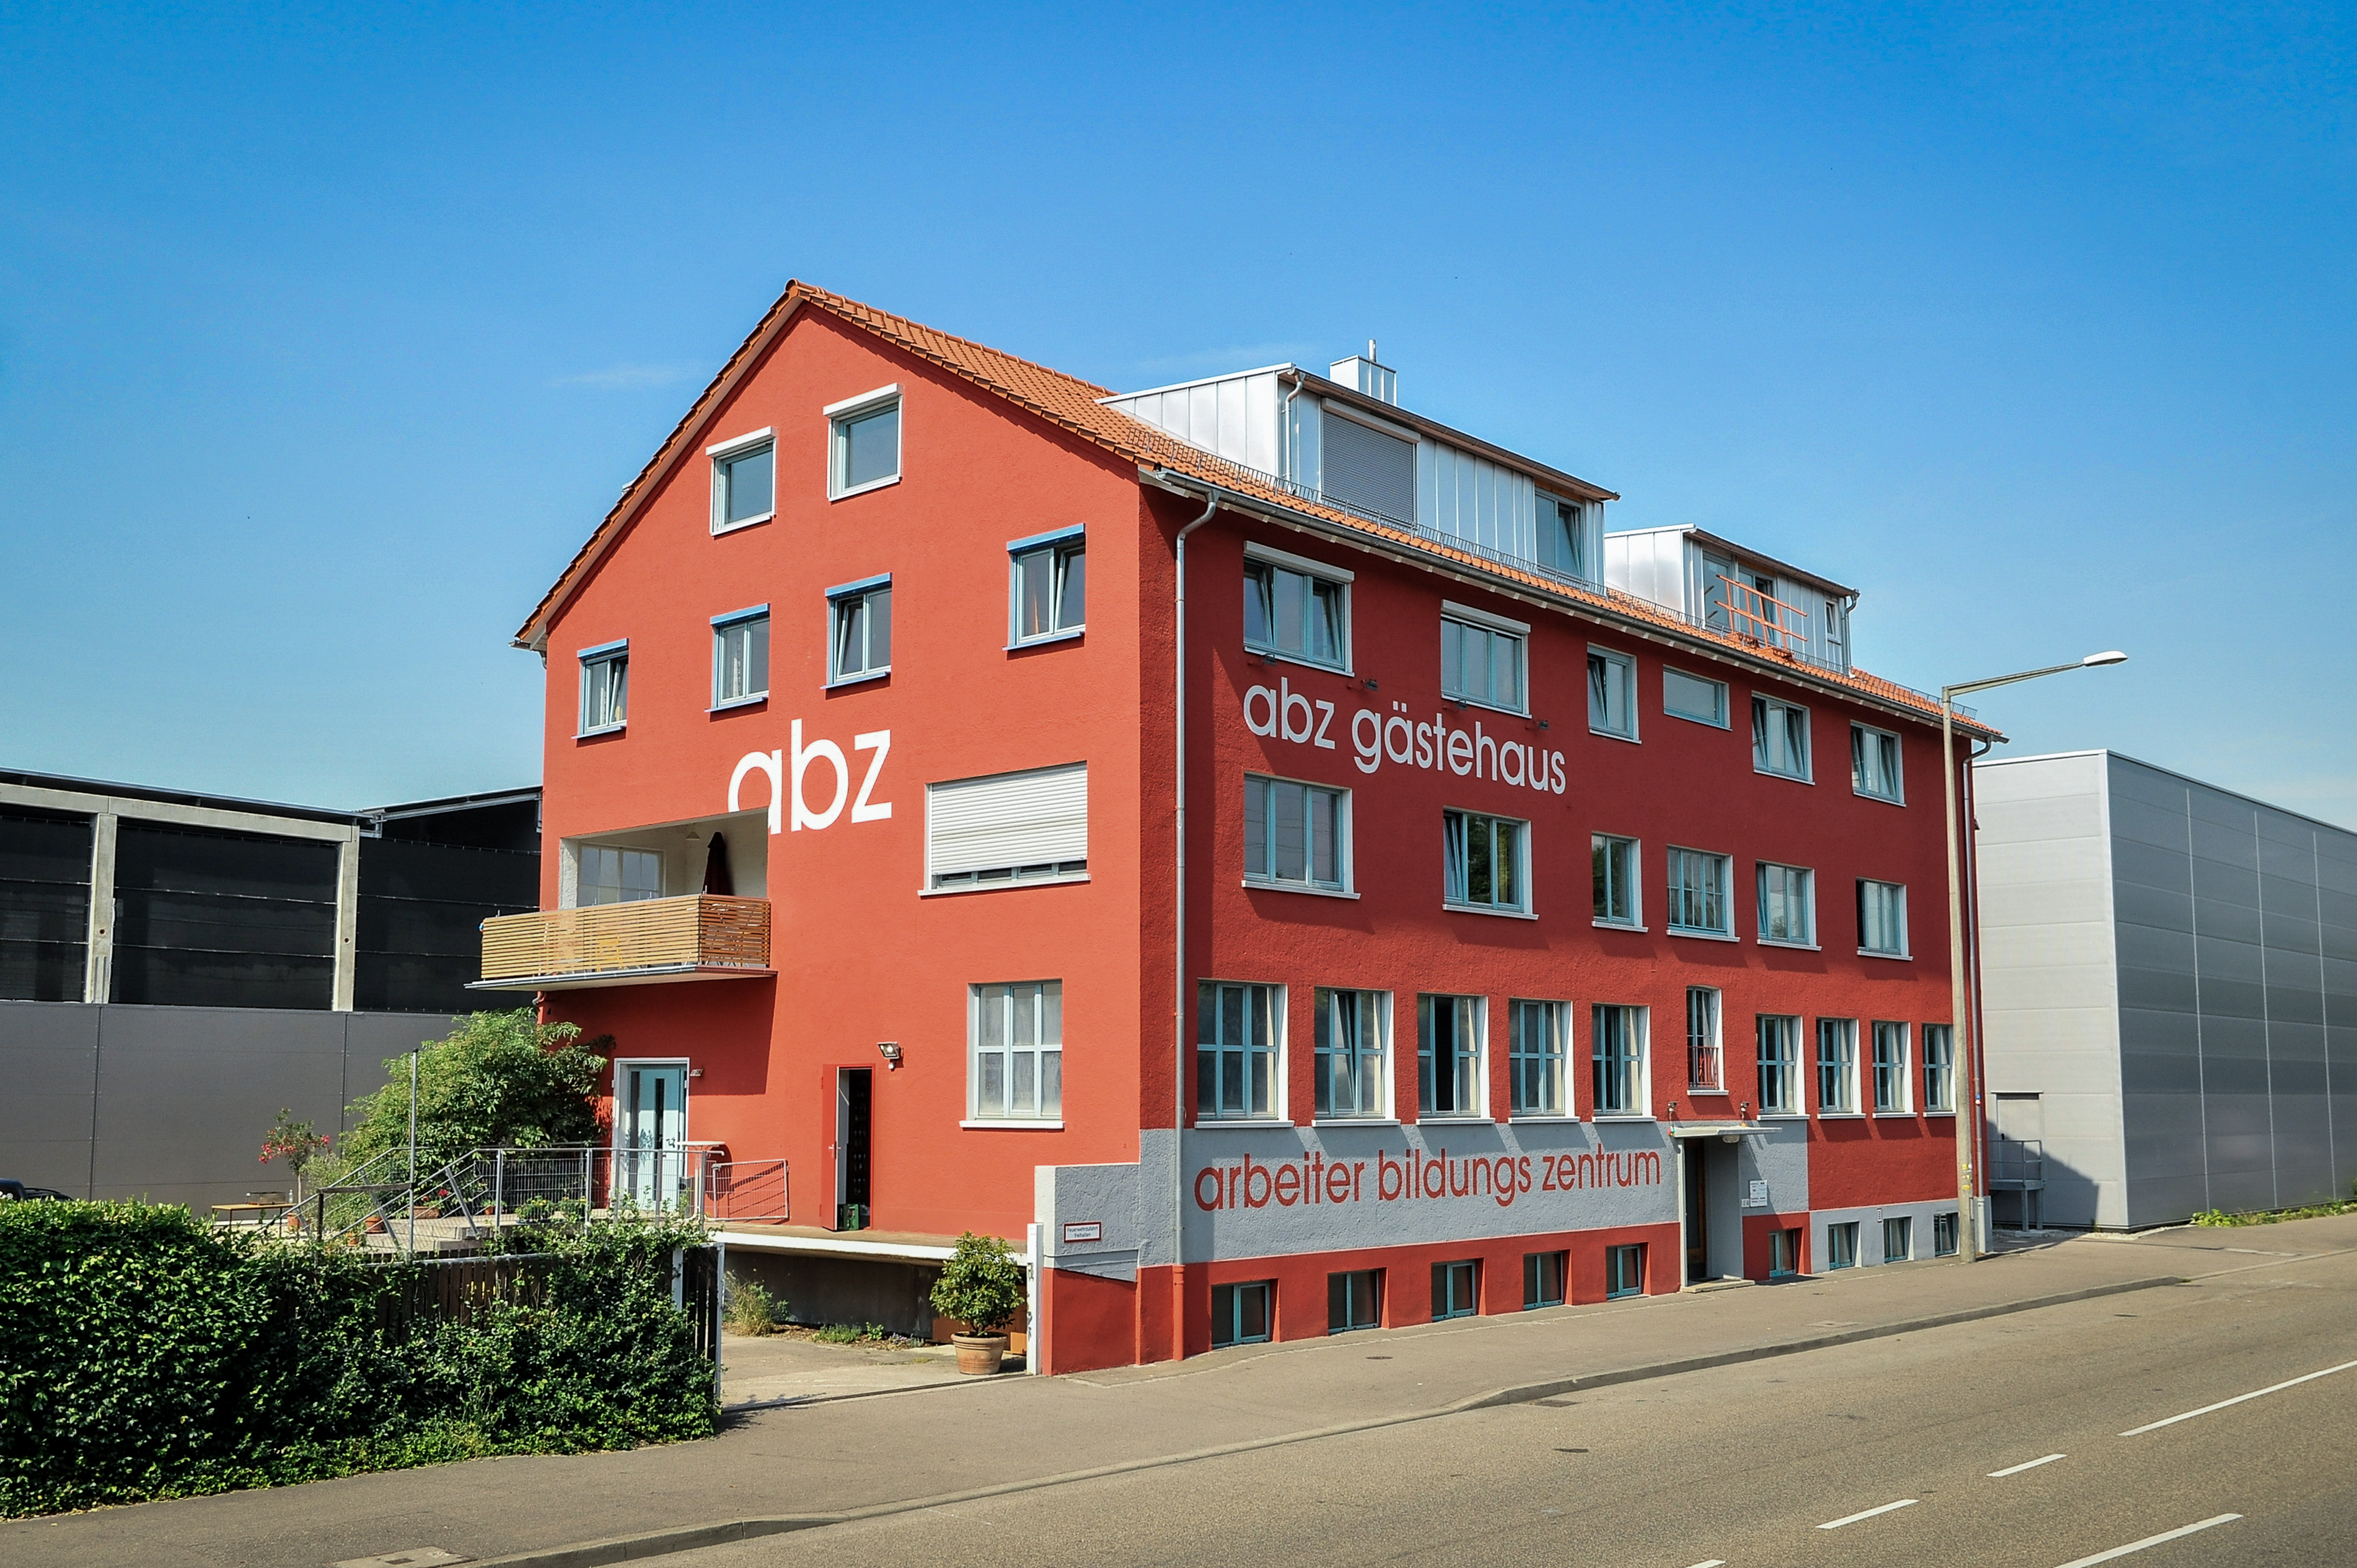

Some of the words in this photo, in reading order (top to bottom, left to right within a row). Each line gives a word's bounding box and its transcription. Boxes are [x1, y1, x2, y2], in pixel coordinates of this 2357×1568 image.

[727, 718, 892, 835] abz
[1243, 676, 1335, 750] abz
[1352, 700, 1566, 795] gästehaus
[1194, 1151, 1366, 1211] arbeiter
[1378, 1149, 1532, 1208] bildungs
[1542, 1143, 1661, 1192] zentrum
